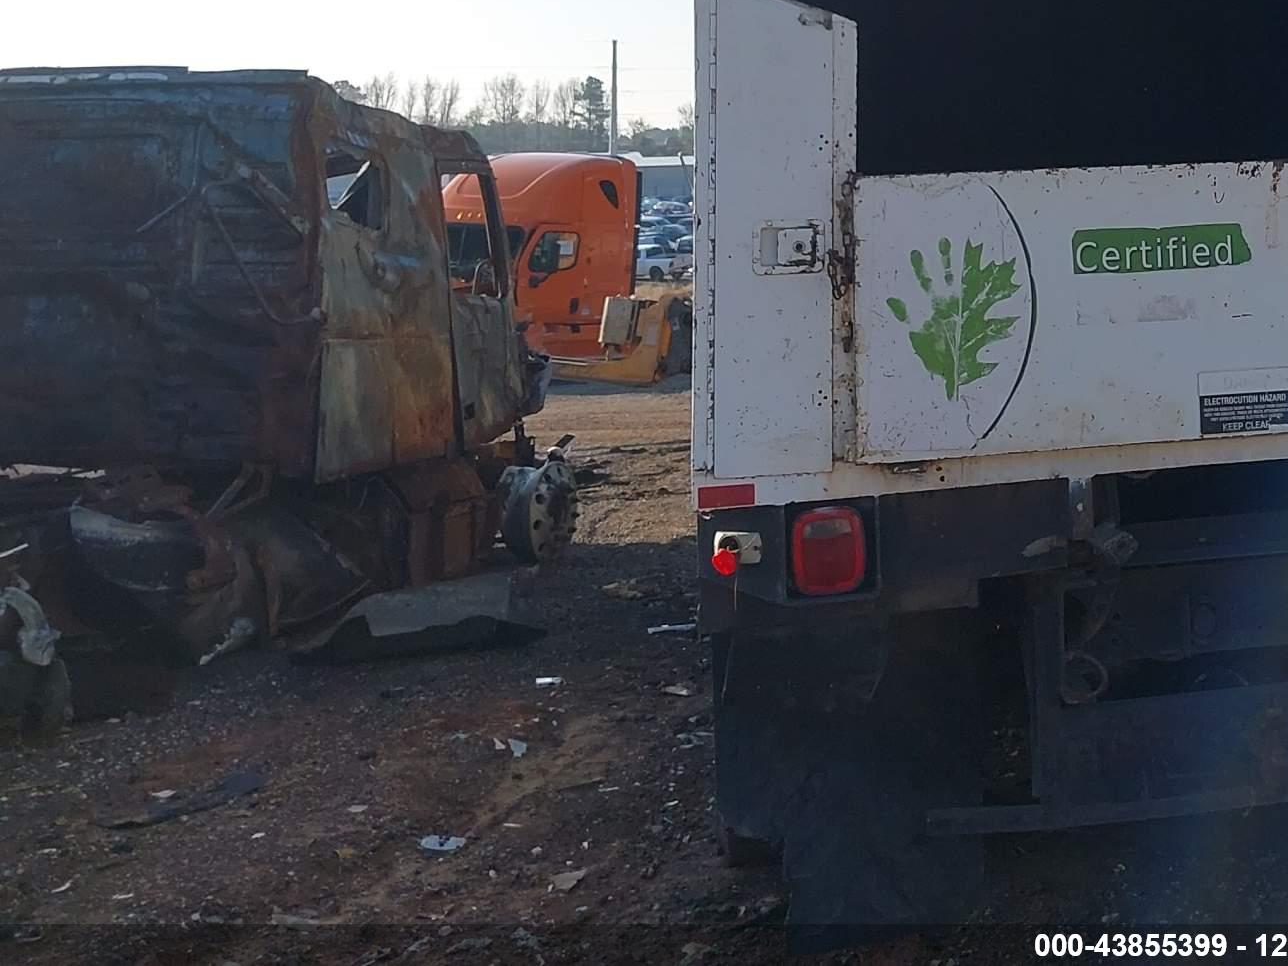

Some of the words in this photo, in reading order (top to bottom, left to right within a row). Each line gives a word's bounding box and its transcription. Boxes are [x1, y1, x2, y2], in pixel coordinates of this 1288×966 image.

[1075, 234, 1233, 272] Certified
[1204, 395, 1258, 406] ELECTROCUTION
[1259, 393, 1287, 402] HAZARD
[1222, 421, 1244, 432] KEEP
